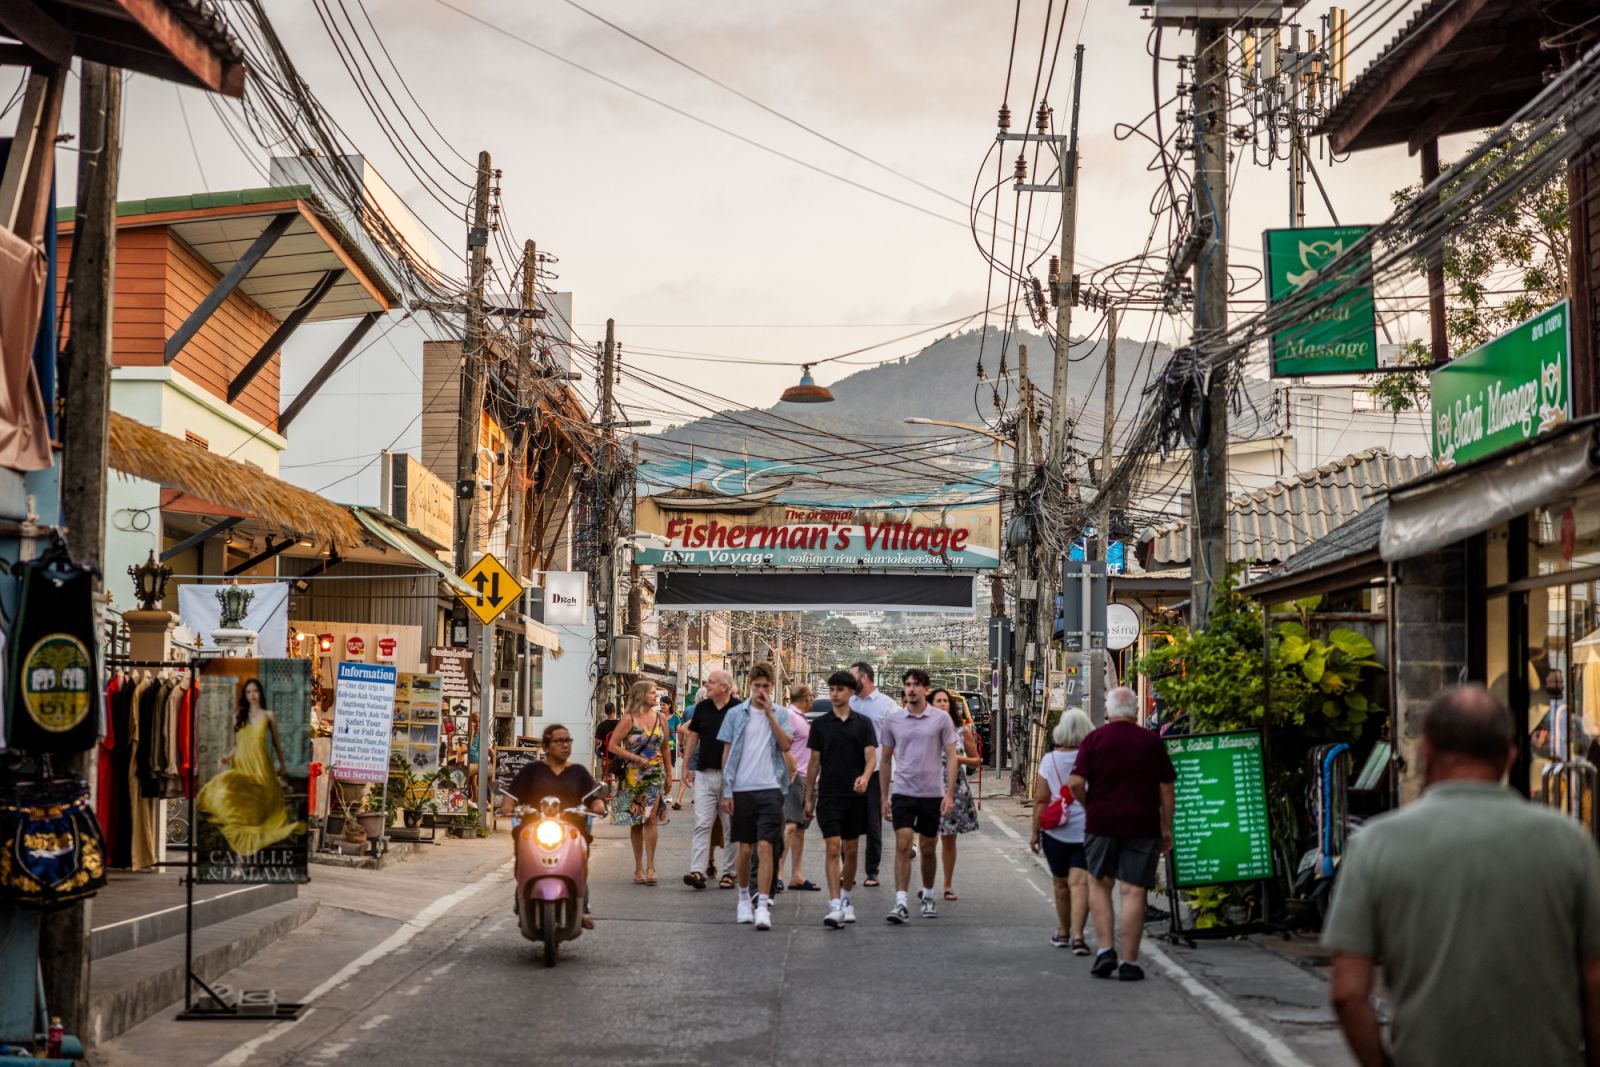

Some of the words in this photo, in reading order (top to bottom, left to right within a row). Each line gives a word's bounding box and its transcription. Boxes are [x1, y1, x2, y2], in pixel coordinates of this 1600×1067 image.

[1285, 339, 1369, 361] Massage
[1454, 391, 1484, 449] Sabai
[1486, 379, 1538, 438] Massage
[785, 509, 804, 520] The
[806, 509, 853, 522] original
[664, 518, 852, 551] Fisherman's
[863, 520, 969, 556] Village
[662, 550, 696, 563] Bon
[708, 550, 775, 565] Voyage
[341, 665, 395, 681] Information
[345, 717, 365, 726] Safari
[365, 719, 381, 727] Tour
[361, 728, 375, 736] Full
[1186, 738, 1214, 751] Sabai
[1217, 736, 1260, 751] Massage
[352, 770, 386, 780] Service
